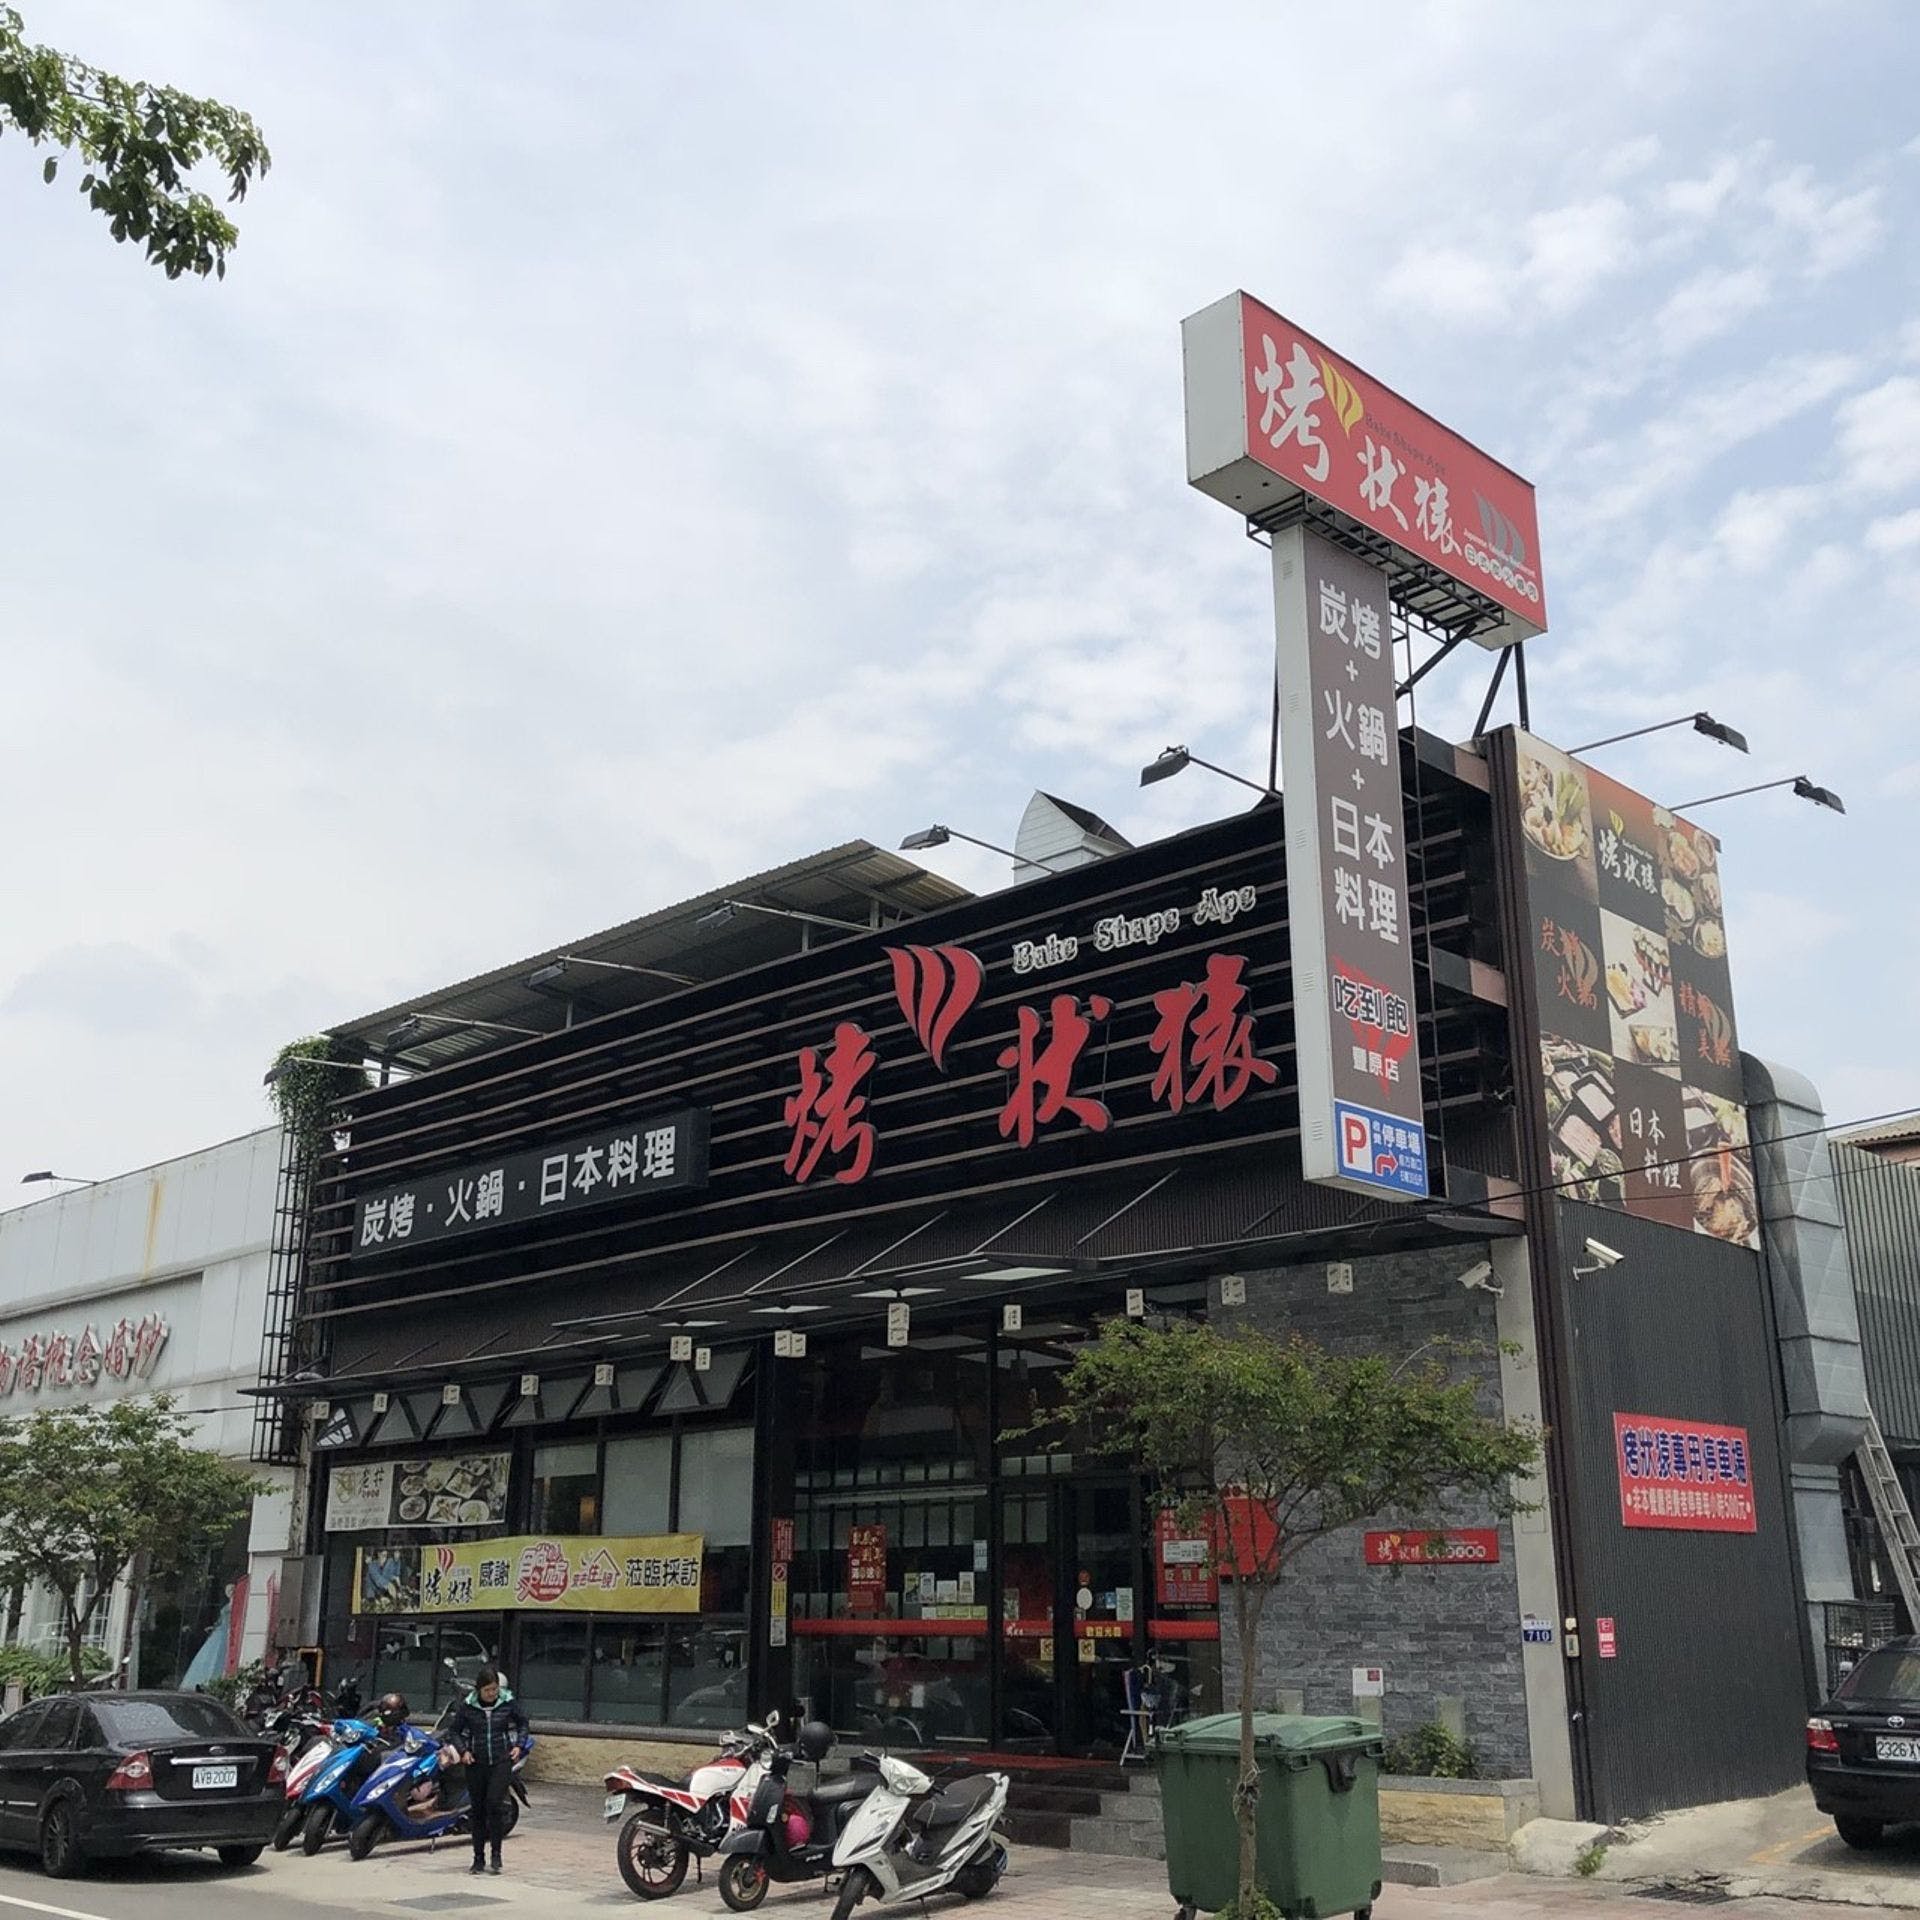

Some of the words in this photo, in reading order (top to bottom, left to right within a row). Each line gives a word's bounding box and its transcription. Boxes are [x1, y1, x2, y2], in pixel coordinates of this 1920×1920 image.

[1319, 579, 1381, 660] 炭烤
[1324, 689, 1388, 766] 火鍋
[1331, 796, 1395, 870] 日本
[1012, 933, 1079, 974] Bake
[1093, 908, 1180, 951] Shape
[1193, 885, 1256, 925] Ape
[1334, 867, 1400, 944] 料理
[1332, 974, 1409, 1037] 吃到飽
[1345, 1117, 1367, 1165] P
[1629, 1106, 1666, 1146] 日本
[1644, 1147, 1682, 1189] 料理
[479, 1559, 510, 1587] 感謝
[1527, 1630, 1550, 1642] 710
